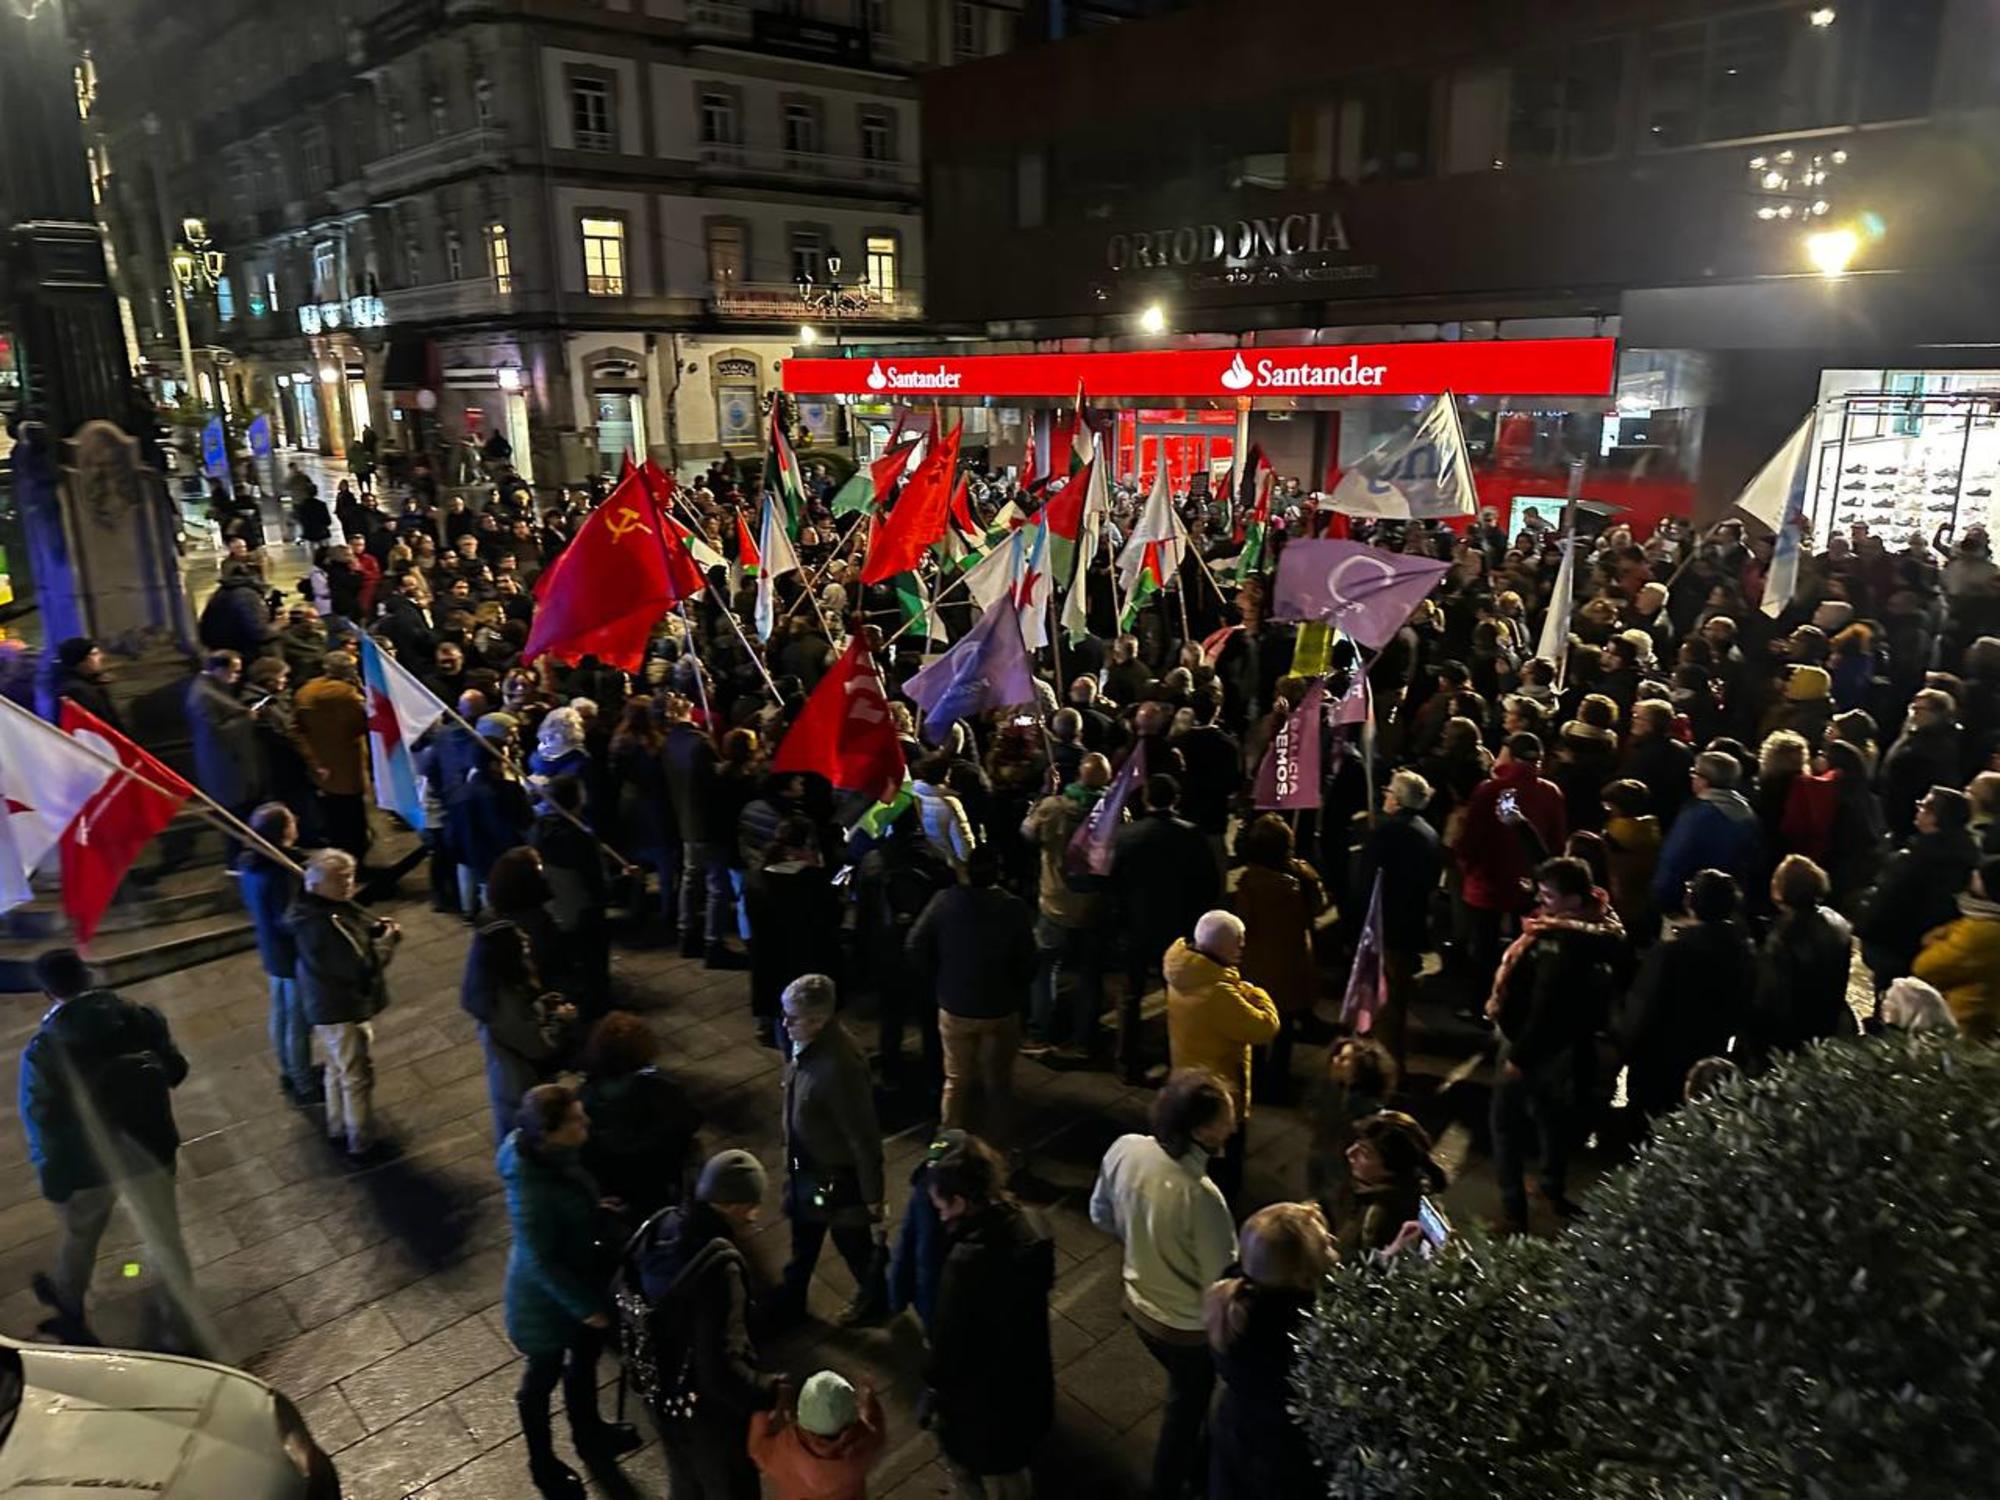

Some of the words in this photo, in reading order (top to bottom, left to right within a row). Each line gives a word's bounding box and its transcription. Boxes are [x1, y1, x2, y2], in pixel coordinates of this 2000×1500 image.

[1108, 212, 1350, 271] ORTODONCIA
[887, 364, 962, 389] Santander
[1256, 354, 1387, 388] Santander
